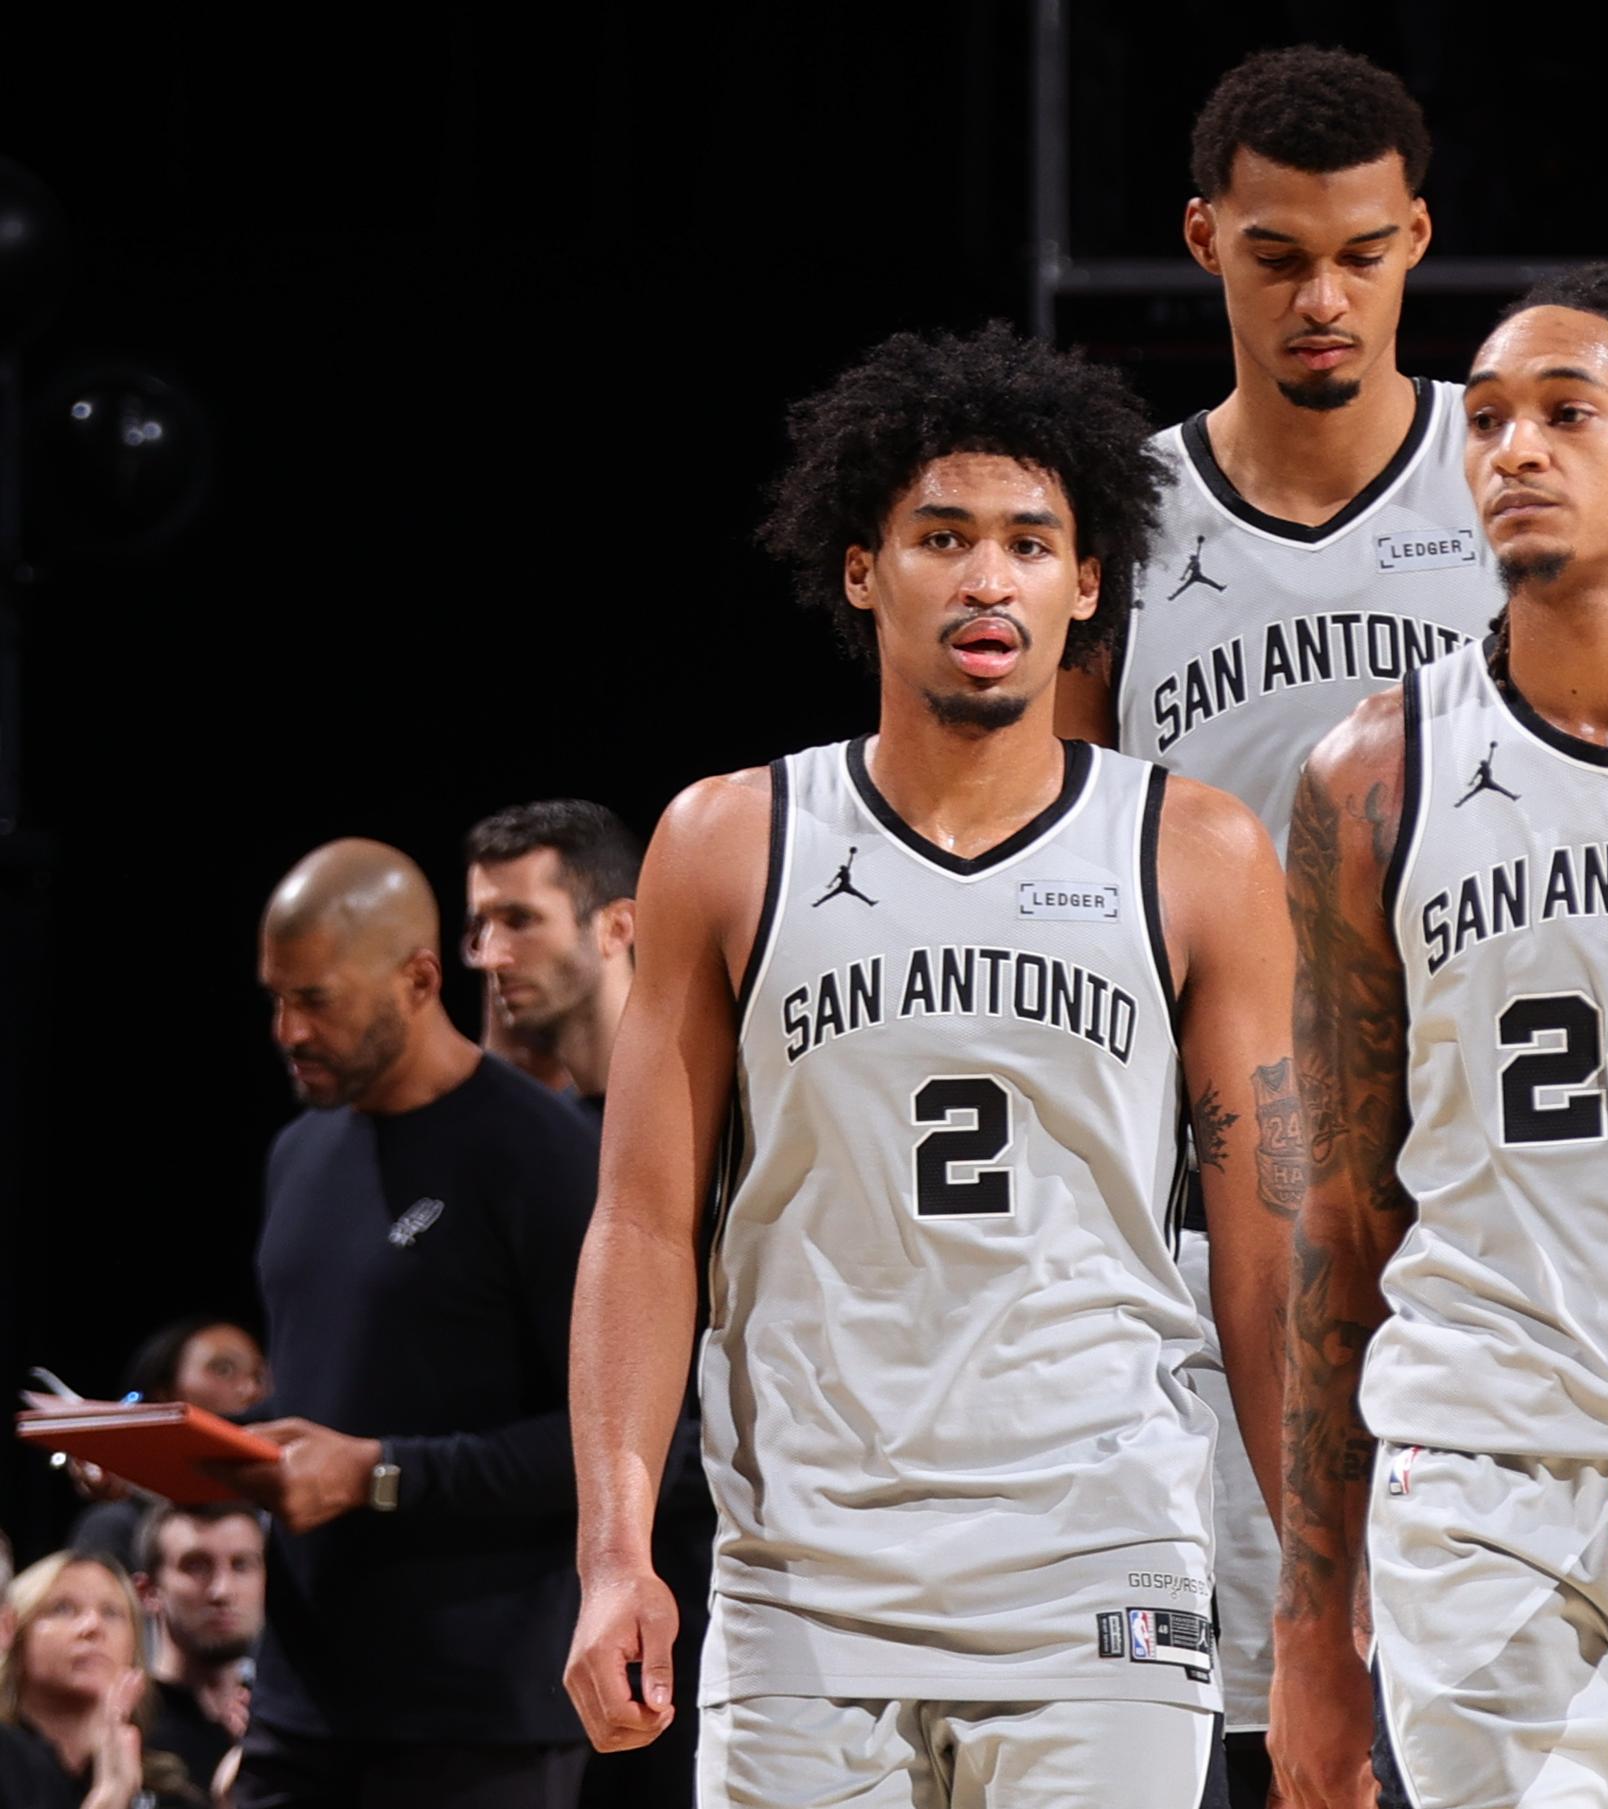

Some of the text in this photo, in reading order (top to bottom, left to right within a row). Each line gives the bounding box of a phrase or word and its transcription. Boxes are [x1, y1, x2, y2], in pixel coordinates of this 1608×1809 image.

[1390, 539, 1463, 558] LEDGER
[1153, 611, 1478, 757] SAN ANTON
[1032, 891, 1106, 909] LEDGER
[1421, 855, 1529, 977] SAN
[782, 944, 1139, 1069] SAN ANTONIO
[910, 1074, 1016, 1220] 2
